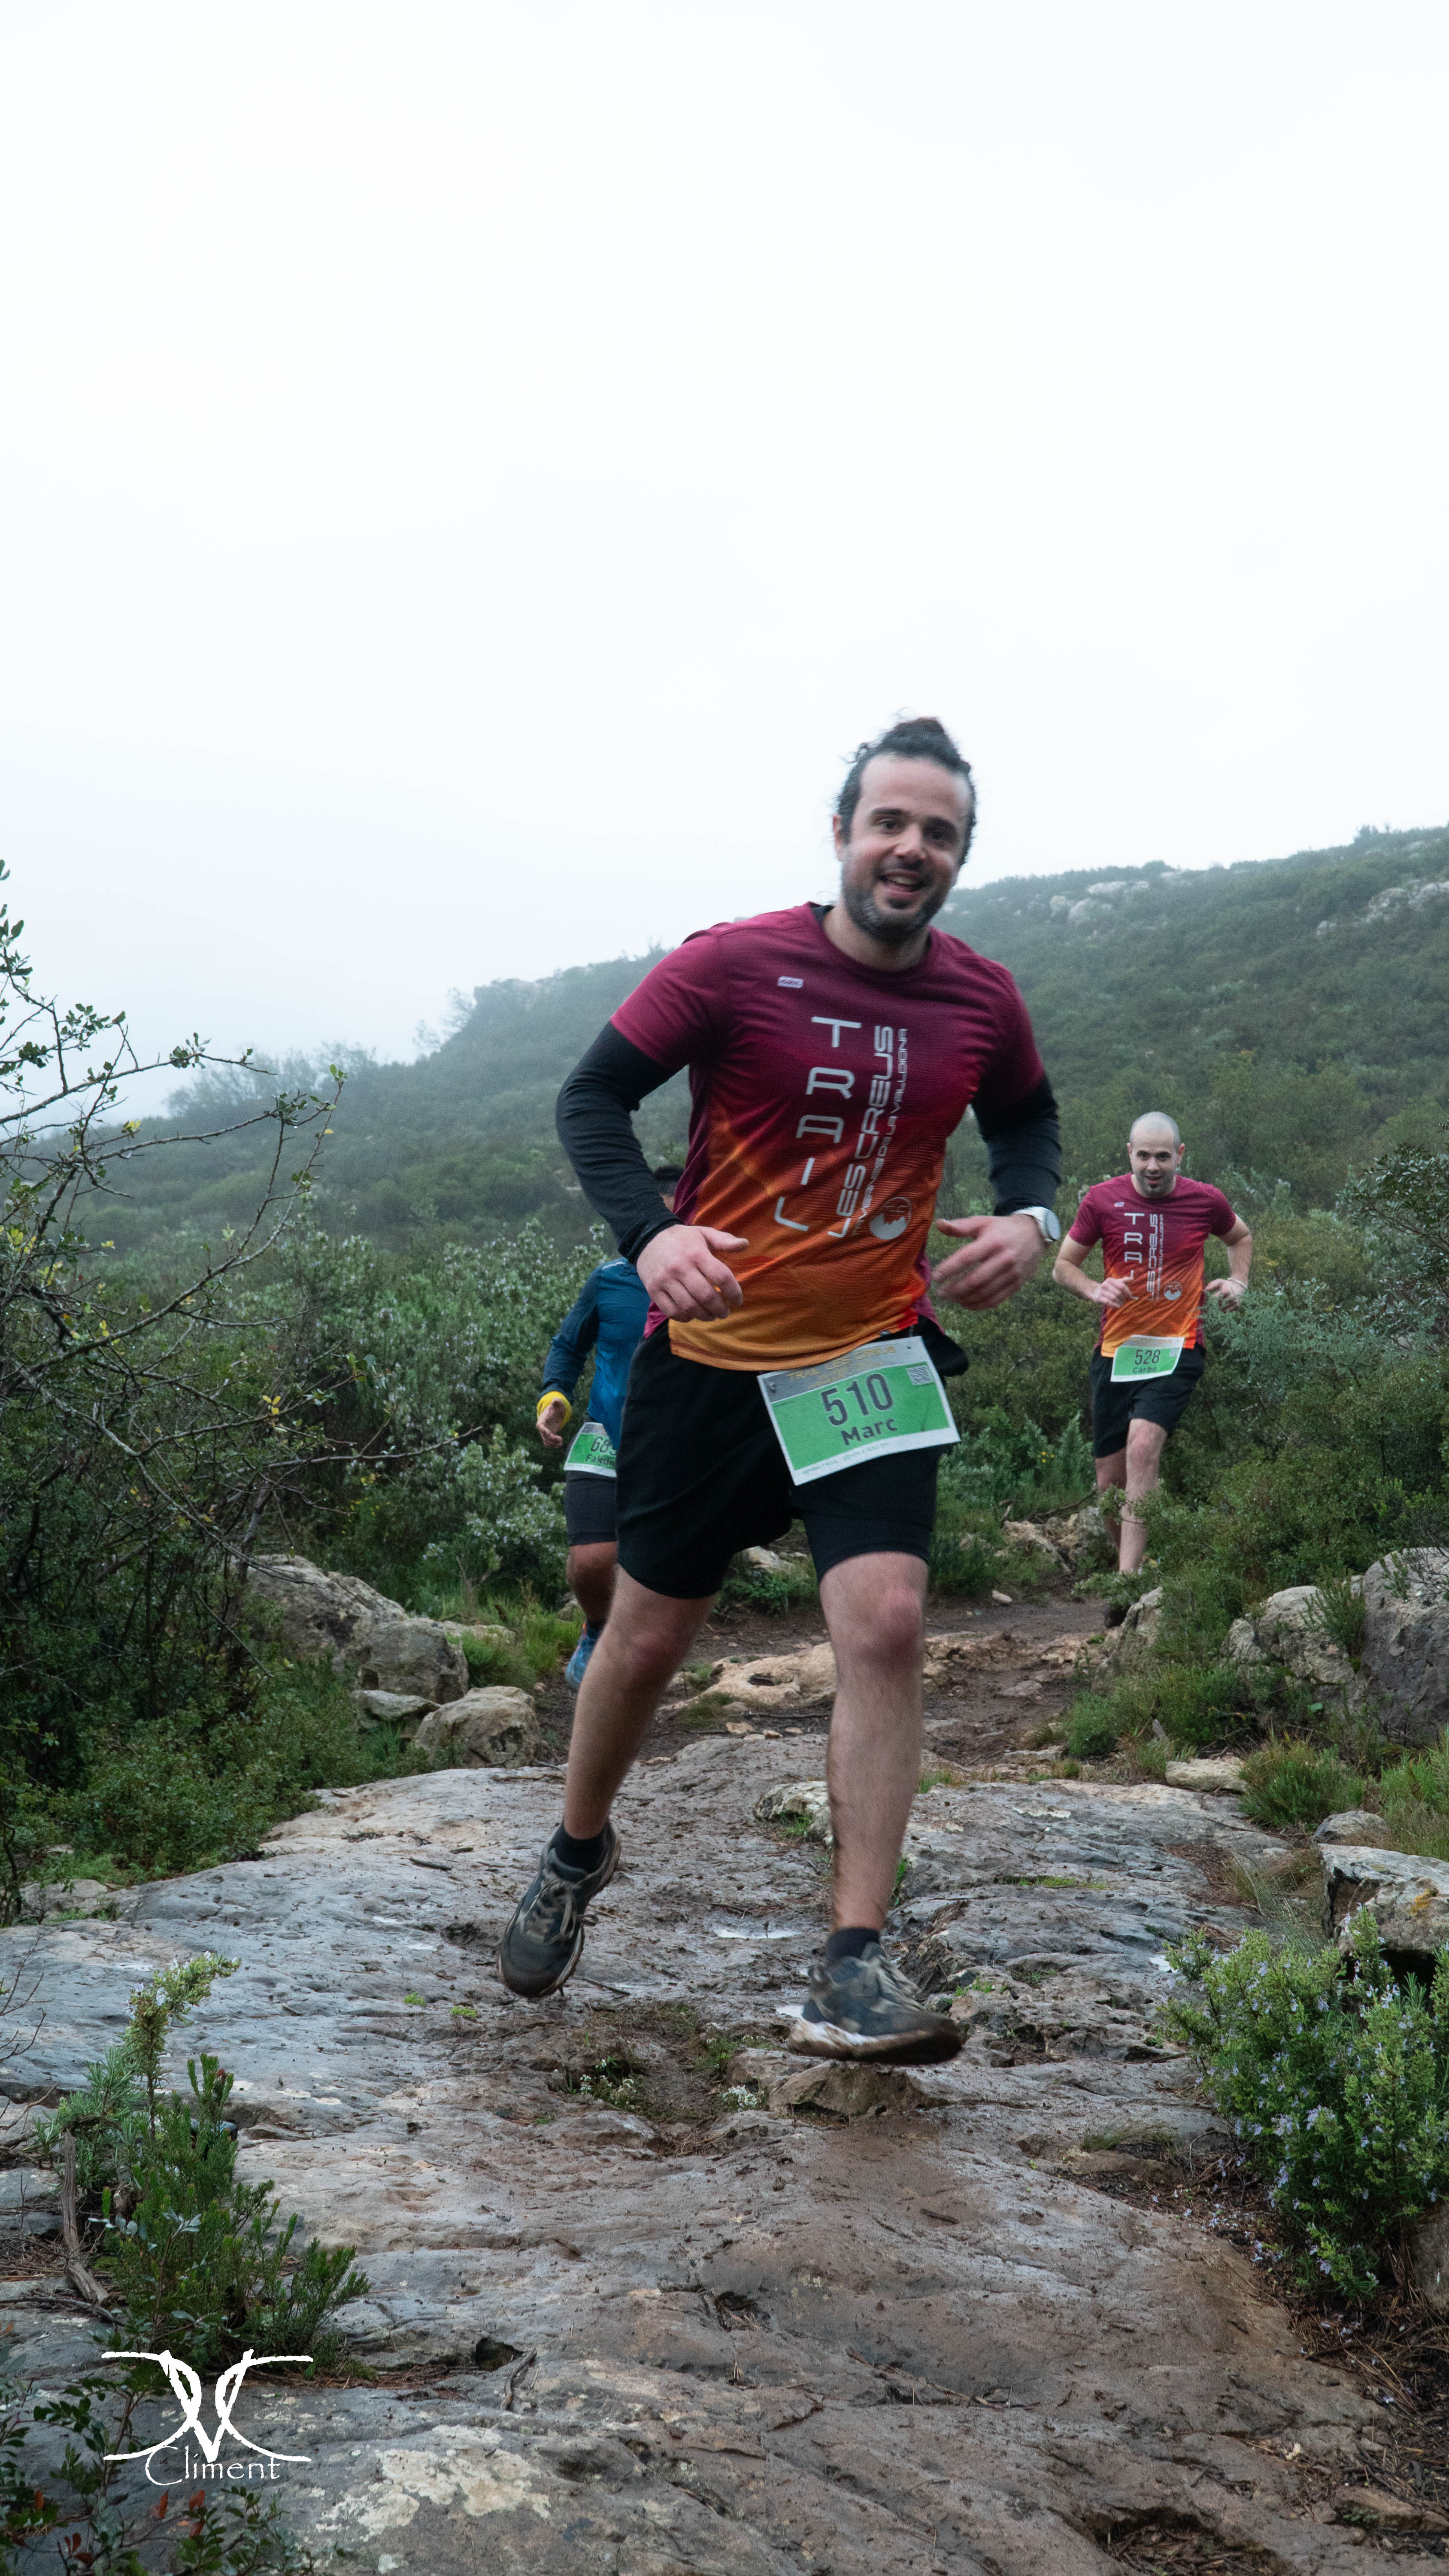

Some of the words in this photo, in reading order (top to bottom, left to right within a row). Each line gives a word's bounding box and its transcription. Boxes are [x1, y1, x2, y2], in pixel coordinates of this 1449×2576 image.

[774, 1016, 862, 1232] TRAIL
[828, 1163, 866, 1238] LES
[855, 1025, 894, 1159] CREUS
[1148, 1214, 1158, 1269] CREUS
[1135, 1349, 1161, 1365] 528
[820, 1373, 893, 1426] 510
[840, 1418, 897, 1446] Marc
